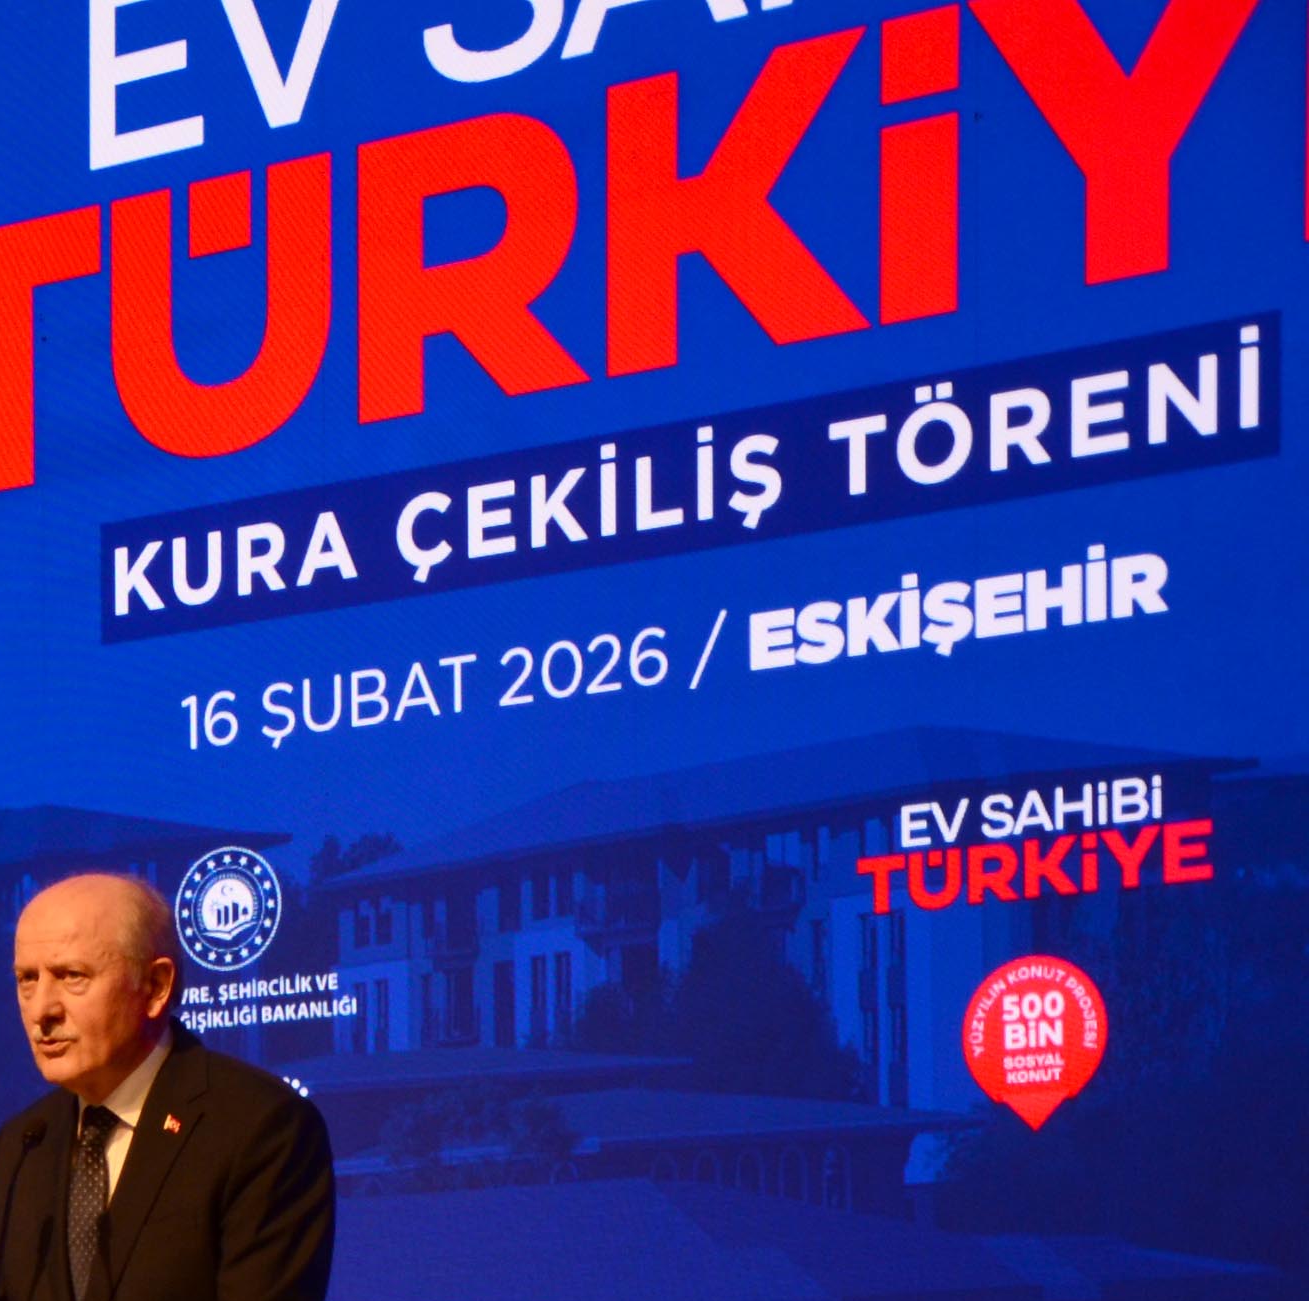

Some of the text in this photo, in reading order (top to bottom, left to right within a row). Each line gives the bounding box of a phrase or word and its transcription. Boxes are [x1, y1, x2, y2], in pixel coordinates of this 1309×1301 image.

[89, 0, 339, 170] EV
[113, 325, 1261, 618] KURA ÇEKİLİŞ TÖRENİ
[180, 690, 240, 751] 16
[261, 653, 478, 749] ŞUBAT
[498, 628, 671, 710] 2026
[749, 544, 1169, 673] ESKİŞEHİR
[900, 797, 970, 848] EV
[218, 973, 312, 1005] ŞEHİRCİLİK
[316, 972, 338, 990] VE
[1007, 965, 1066, 984] KONUT
[261, 995, 358, 1024] BAKANLIĞI
[1002, 990, 1065, 1021] 500
[1003, 1053, 1065, 1070] SOSYAL
[1006, 1067, 1062, 1084] KONUT
